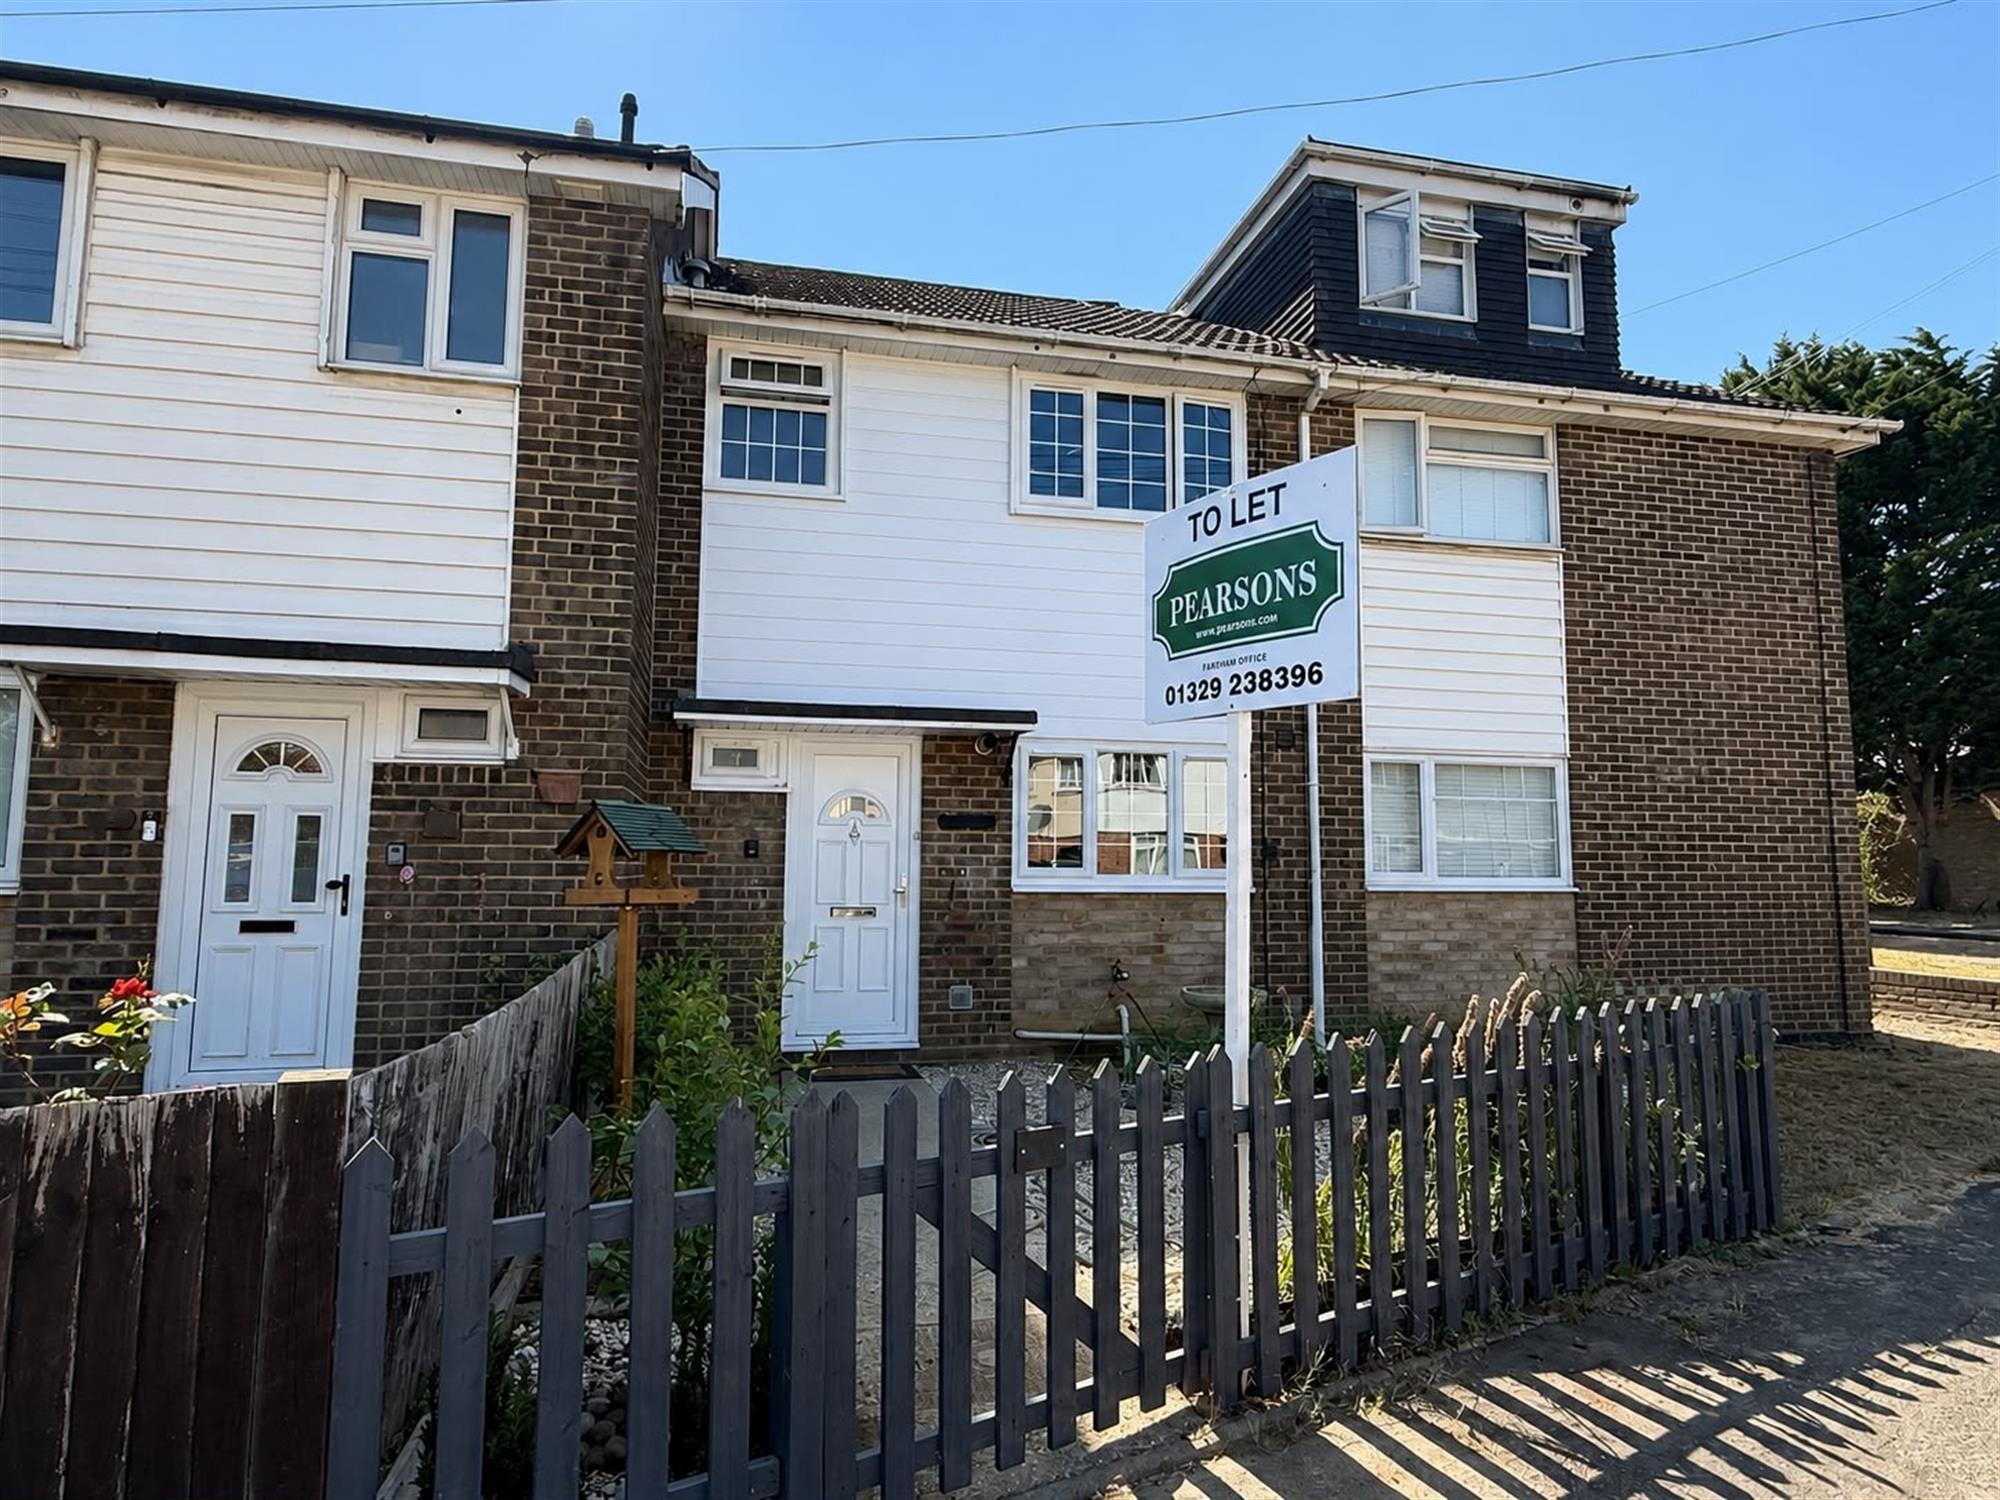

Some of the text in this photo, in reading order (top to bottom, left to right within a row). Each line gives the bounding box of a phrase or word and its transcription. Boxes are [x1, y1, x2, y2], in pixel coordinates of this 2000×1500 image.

[1188, 482, 1287, 542] TO LET
[1169, 559, 1317, 627] PEARSONS
[1195, 613, 1278, 639] www.pearsons.com
[1238, 652, 1267, 667] OFFICE
[1165, 661, 1323, 706] 01329 238396
